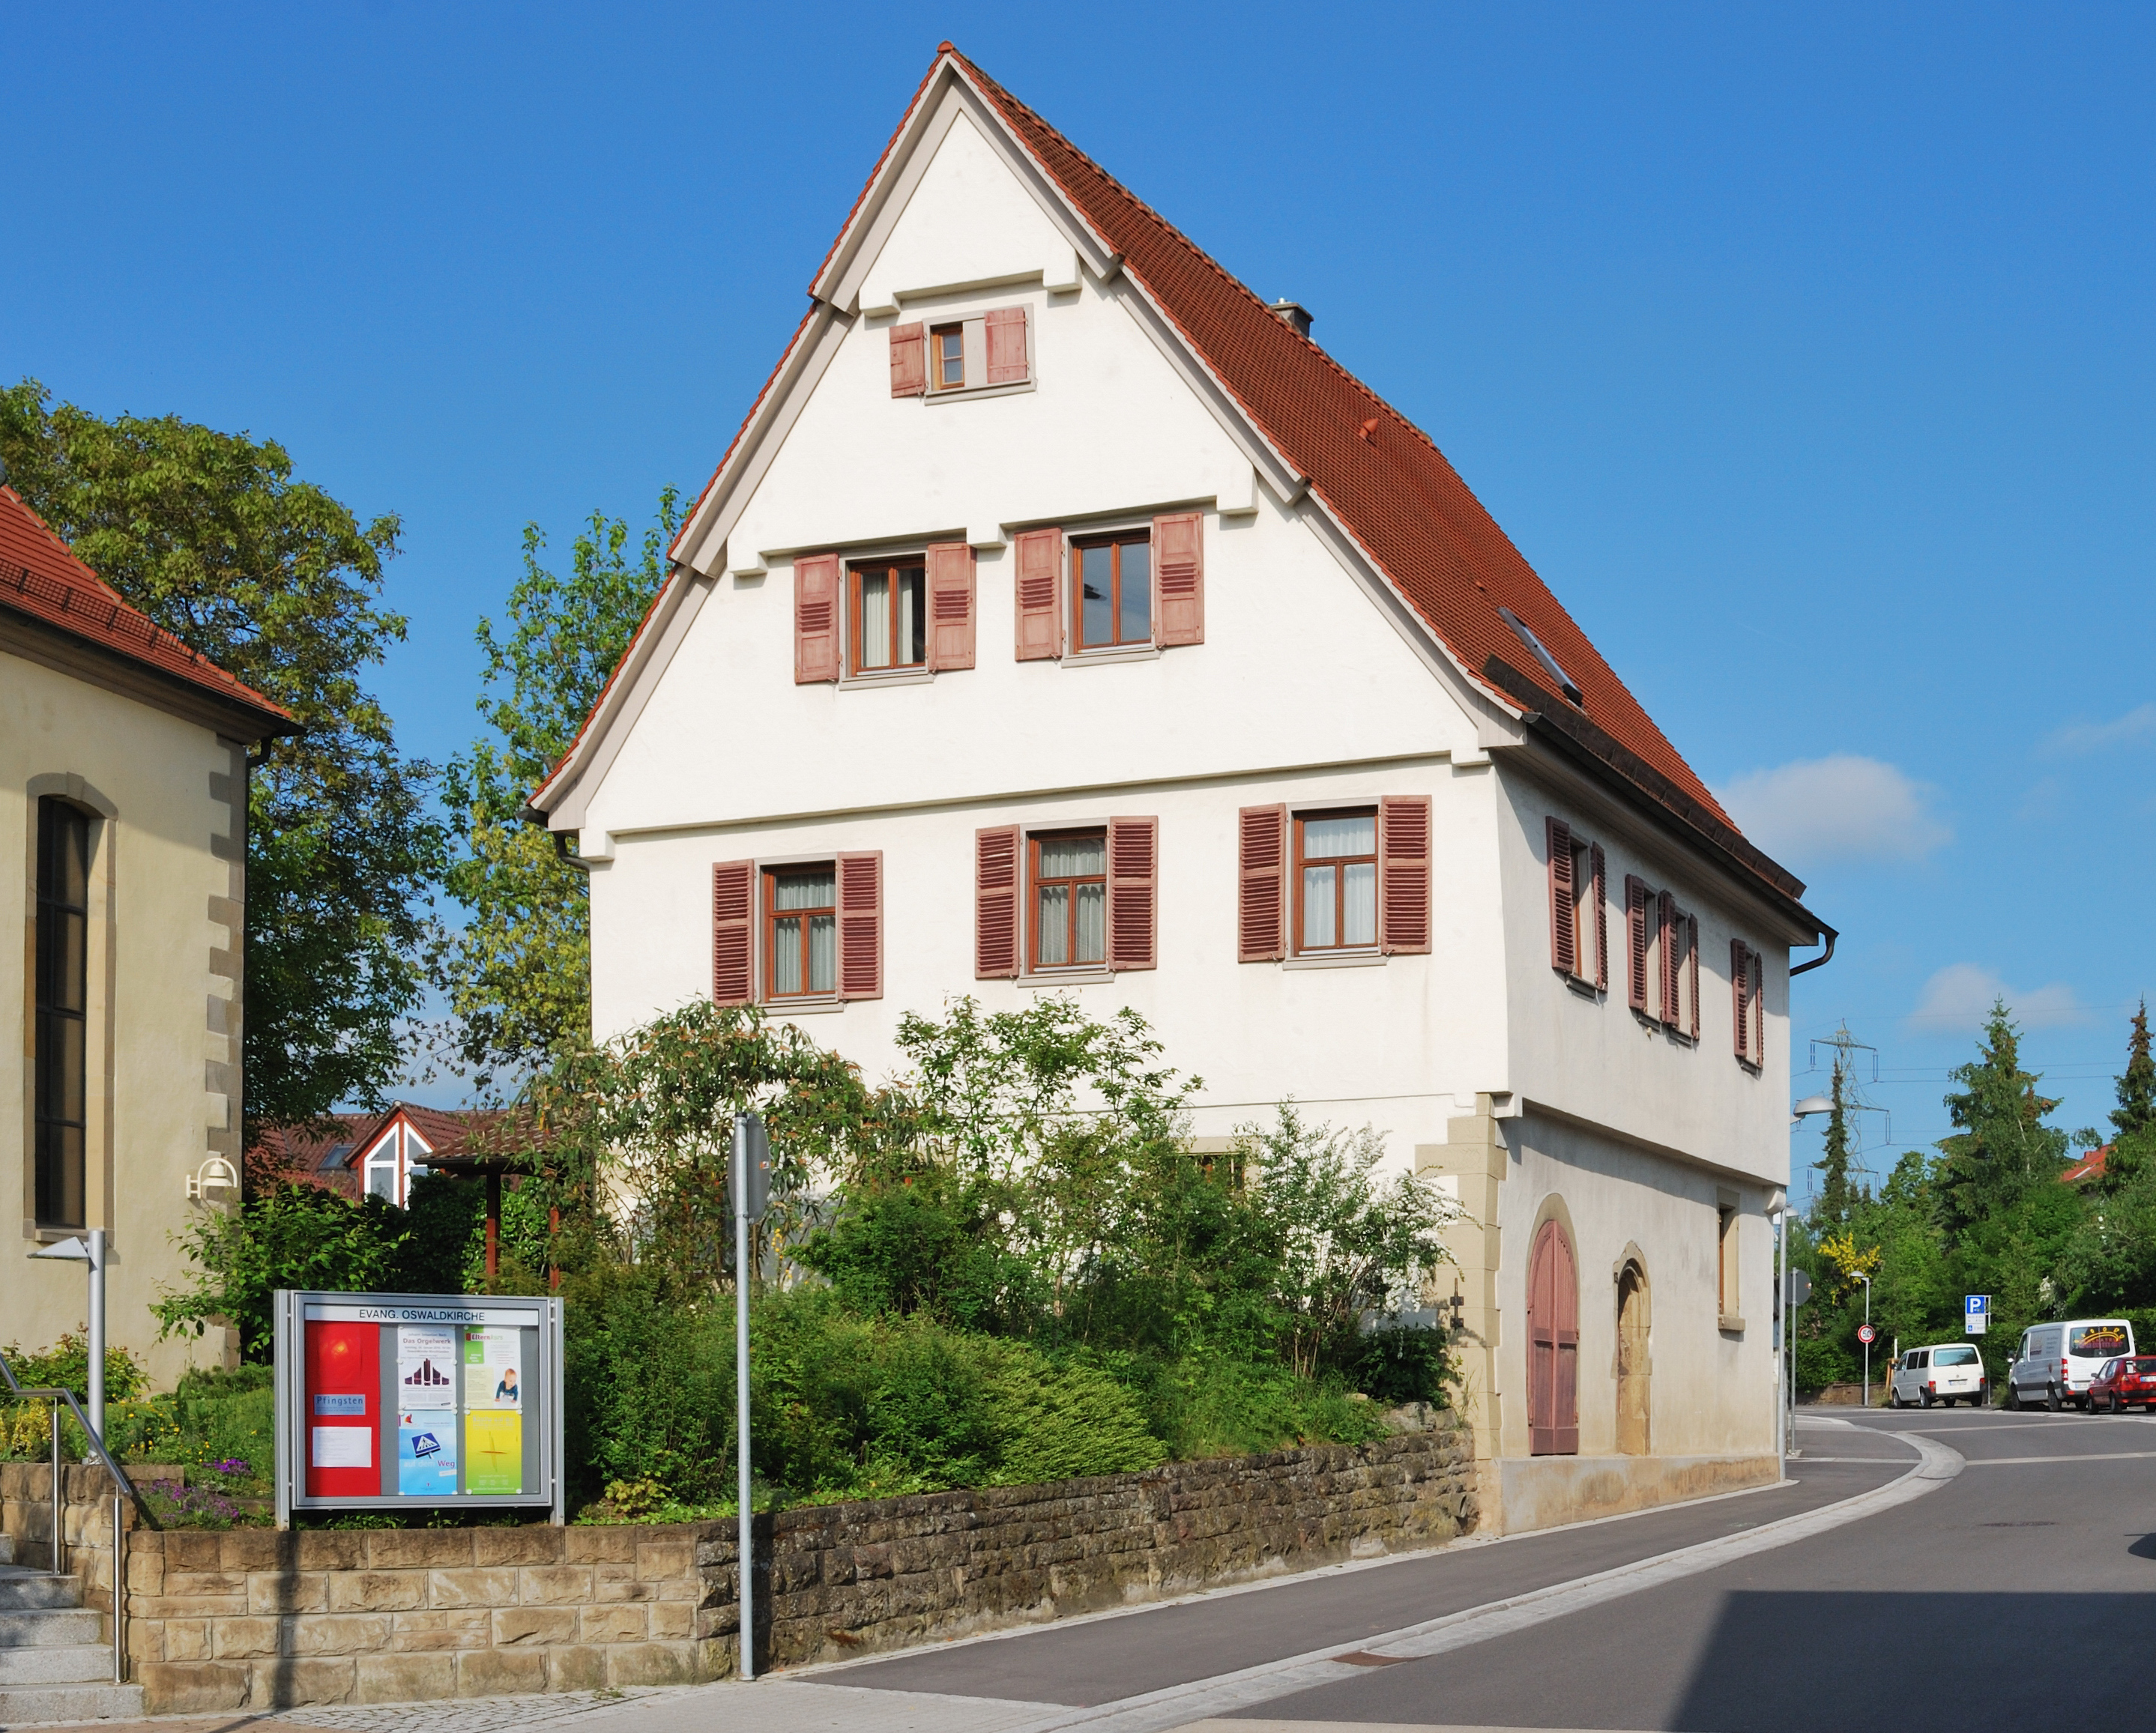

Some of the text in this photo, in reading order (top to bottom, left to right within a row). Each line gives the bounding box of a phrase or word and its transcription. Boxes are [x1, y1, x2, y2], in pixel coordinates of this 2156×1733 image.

[1970, 1298, 1981, 1313] P
[359, 1309, 485, 1321] EVANG. OSWALDKIRCHE
[316, 1396, 363, 1406] Pfingsten
[437, 1460, 456, 1469] Weg
